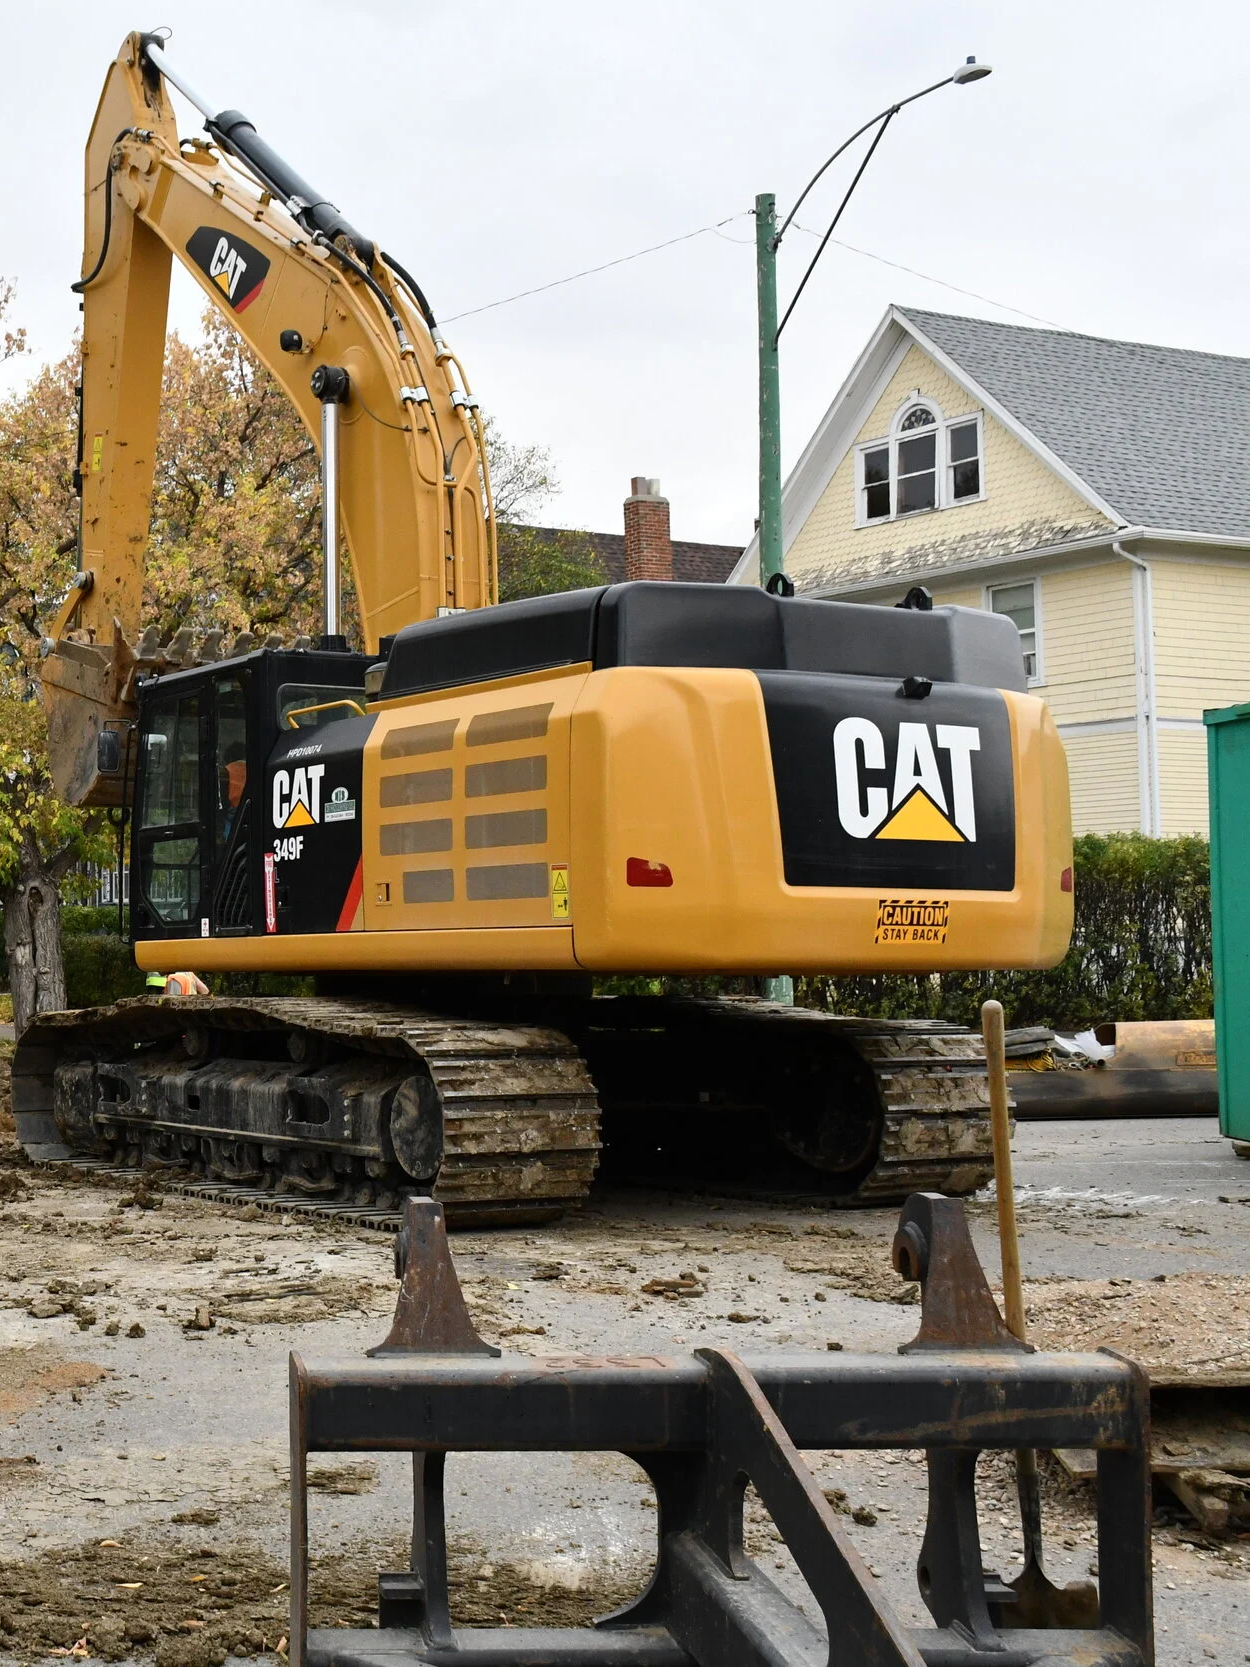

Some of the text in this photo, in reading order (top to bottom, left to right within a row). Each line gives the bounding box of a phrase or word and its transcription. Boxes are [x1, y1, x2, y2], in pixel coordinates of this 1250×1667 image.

[210, 236, 247, 300] CAT
[287, 744, 322, 758] HPD10074
[833, 716, 981, 842] CAT
[272, 763, 325, 829] CAT
[273, 836, 304, 862] 349F
[883, 907, 944, 925] CAUTION
[882, 928, 940, 941] STAY BACK
